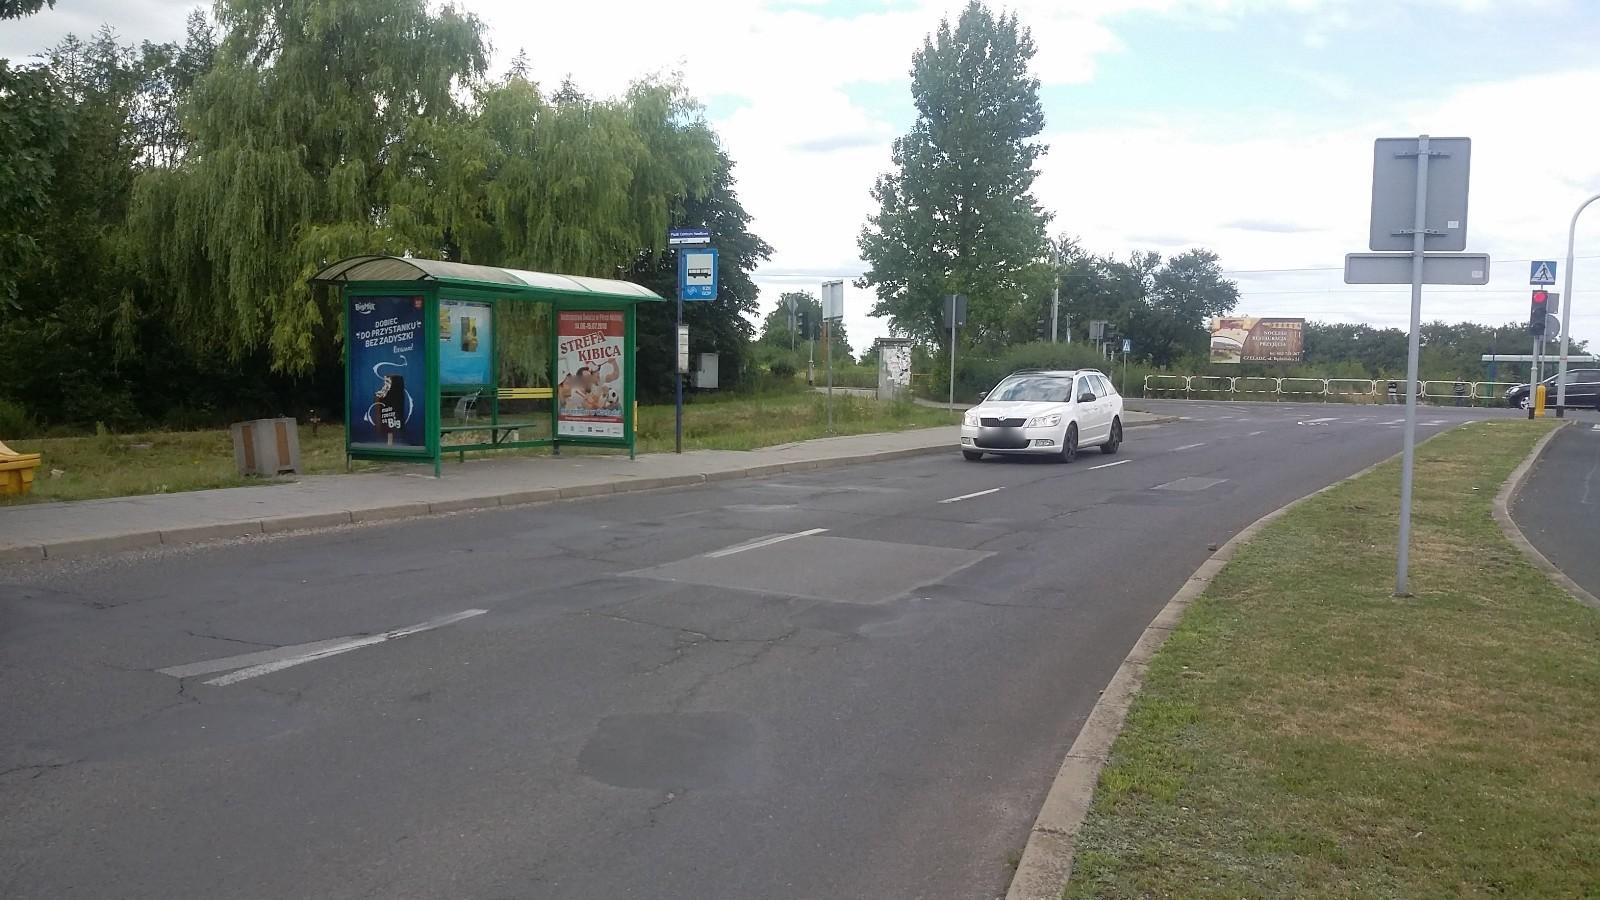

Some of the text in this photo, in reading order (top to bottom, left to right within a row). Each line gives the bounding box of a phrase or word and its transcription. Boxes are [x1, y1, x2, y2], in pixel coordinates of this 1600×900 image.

[360, 321, 416, 340] DO PRZYSTANKU
[375, 317, 399, 328] DOBIEC
[365, 331, 414, 348] BEZ ZADYSZKI
[560, 330, 606, 354] STREFA
[578, 345, 621, 362] KIBICA
[387, 416, 401, 429] Big
